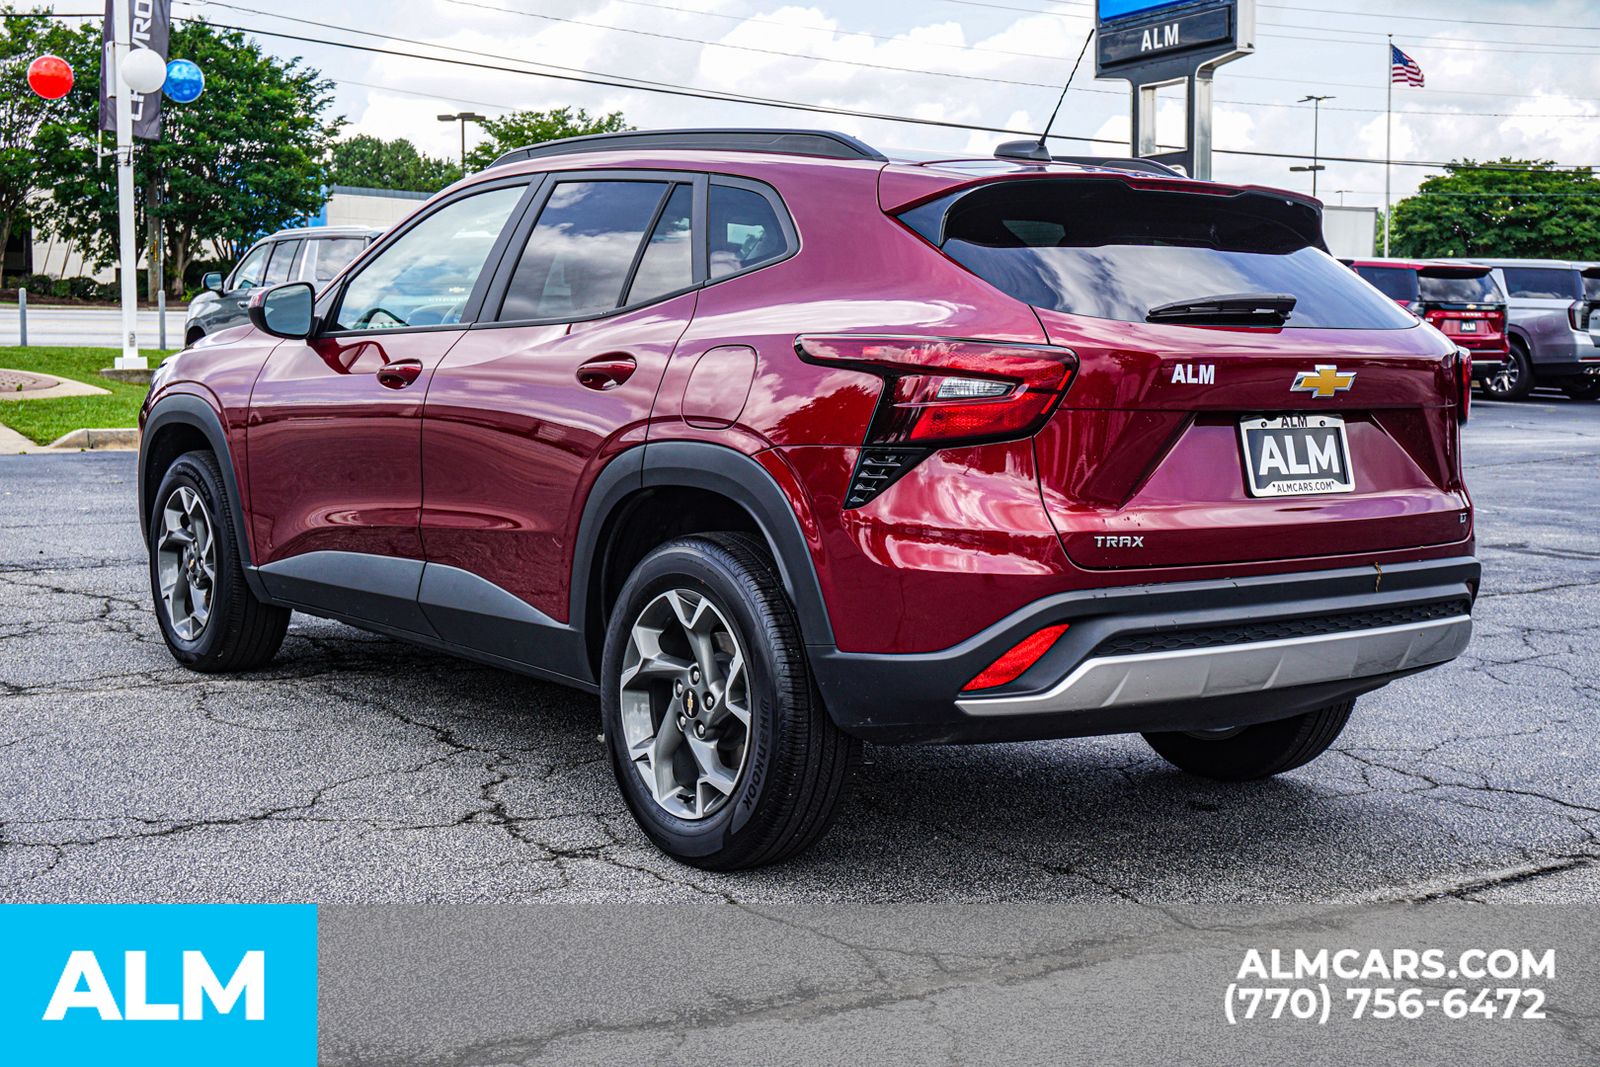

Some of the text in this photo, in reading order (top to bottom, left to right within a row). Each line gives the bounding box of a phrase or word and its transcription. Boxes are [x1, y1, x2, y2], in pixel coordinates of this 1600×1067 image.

[1141, 23, 1179, 52] ALM
[1171, 363, 1215, 385] ALM
[1281, 415, 1308, 428] ALM
[1259, 434, 1340, 475] ALM
[1277, 481, 1333, 493] ALMCARS.COM
[1093, 535, 1145, 548] TRAX
